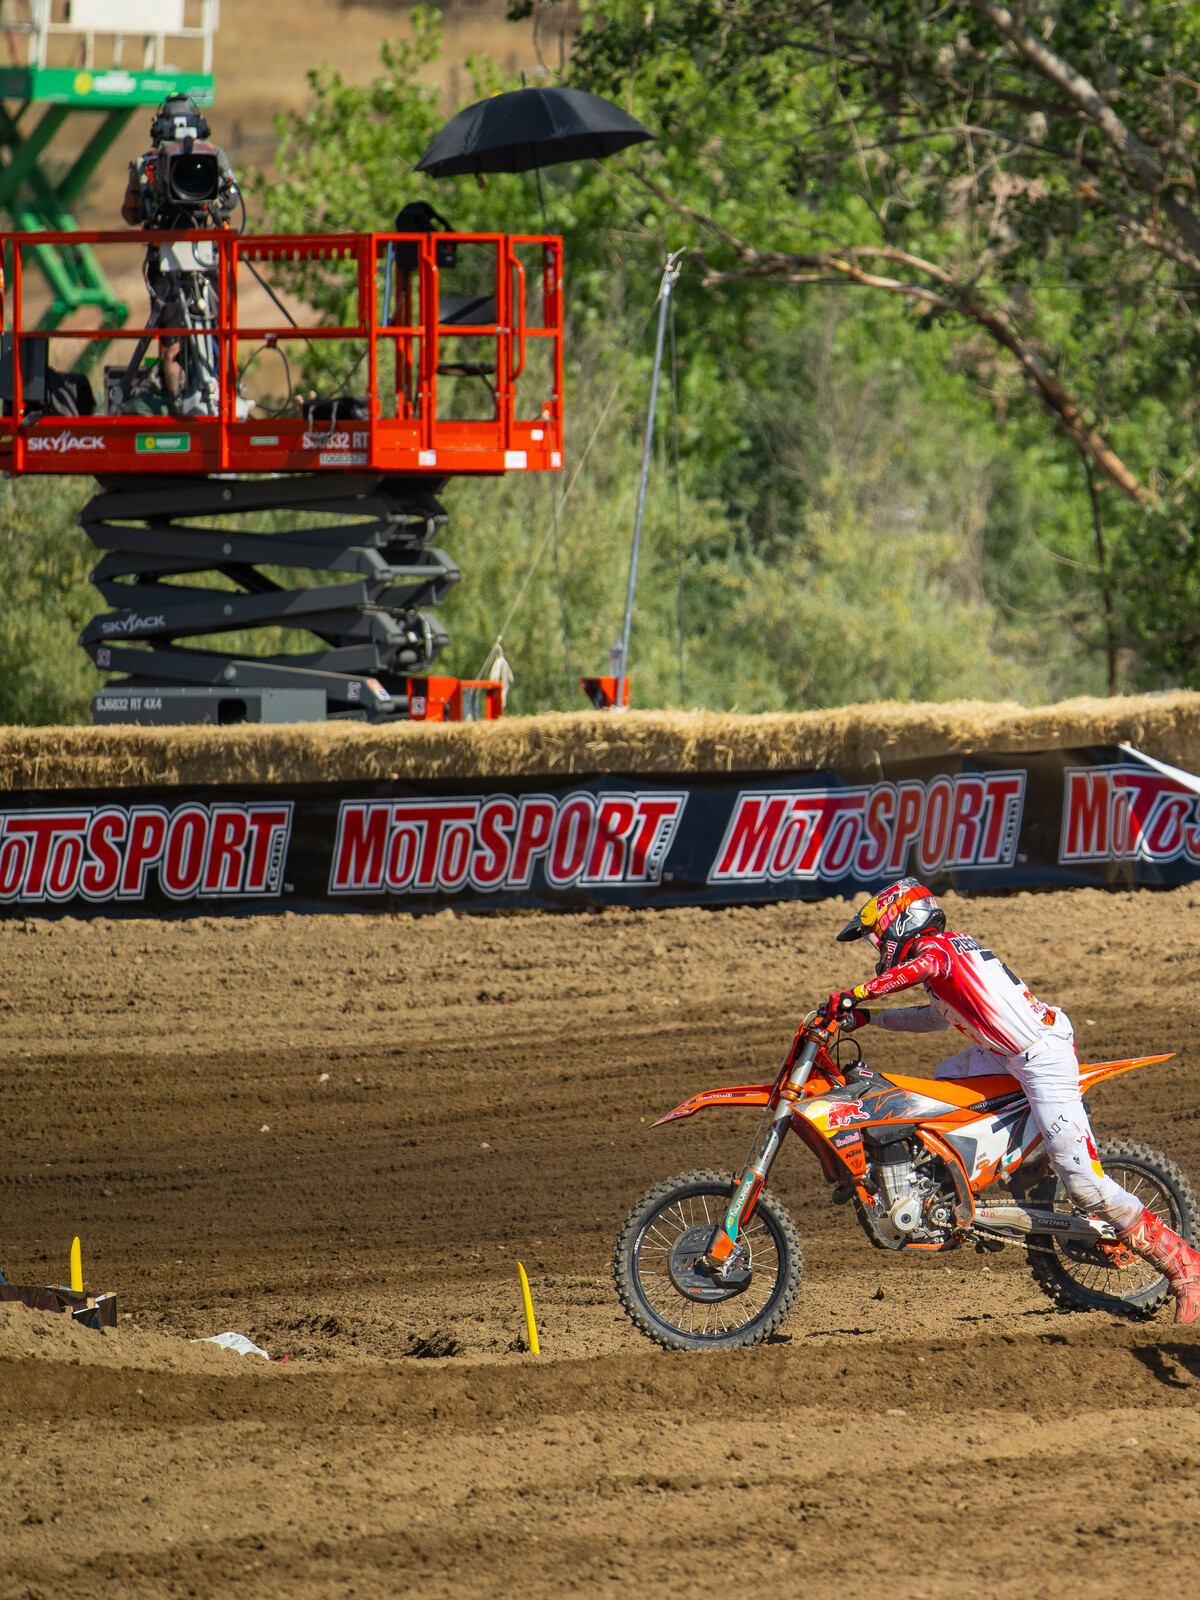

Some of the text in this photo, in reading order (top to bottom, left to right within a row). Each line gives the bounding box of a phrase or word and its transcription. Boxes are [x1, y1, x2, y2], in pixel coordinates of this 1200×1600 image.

[27, 430, 106, 453] SKYJACK
[352, 432, 369, 449] RT
[101, 613, 166, 633] SKYJACK
[96, 697, 129, 711] SJ6832
[130, 697, 143, 710] RT
[991, 1107, 1032, 1156] 7
[730, 1179, 753, 1217] MOTOREX
